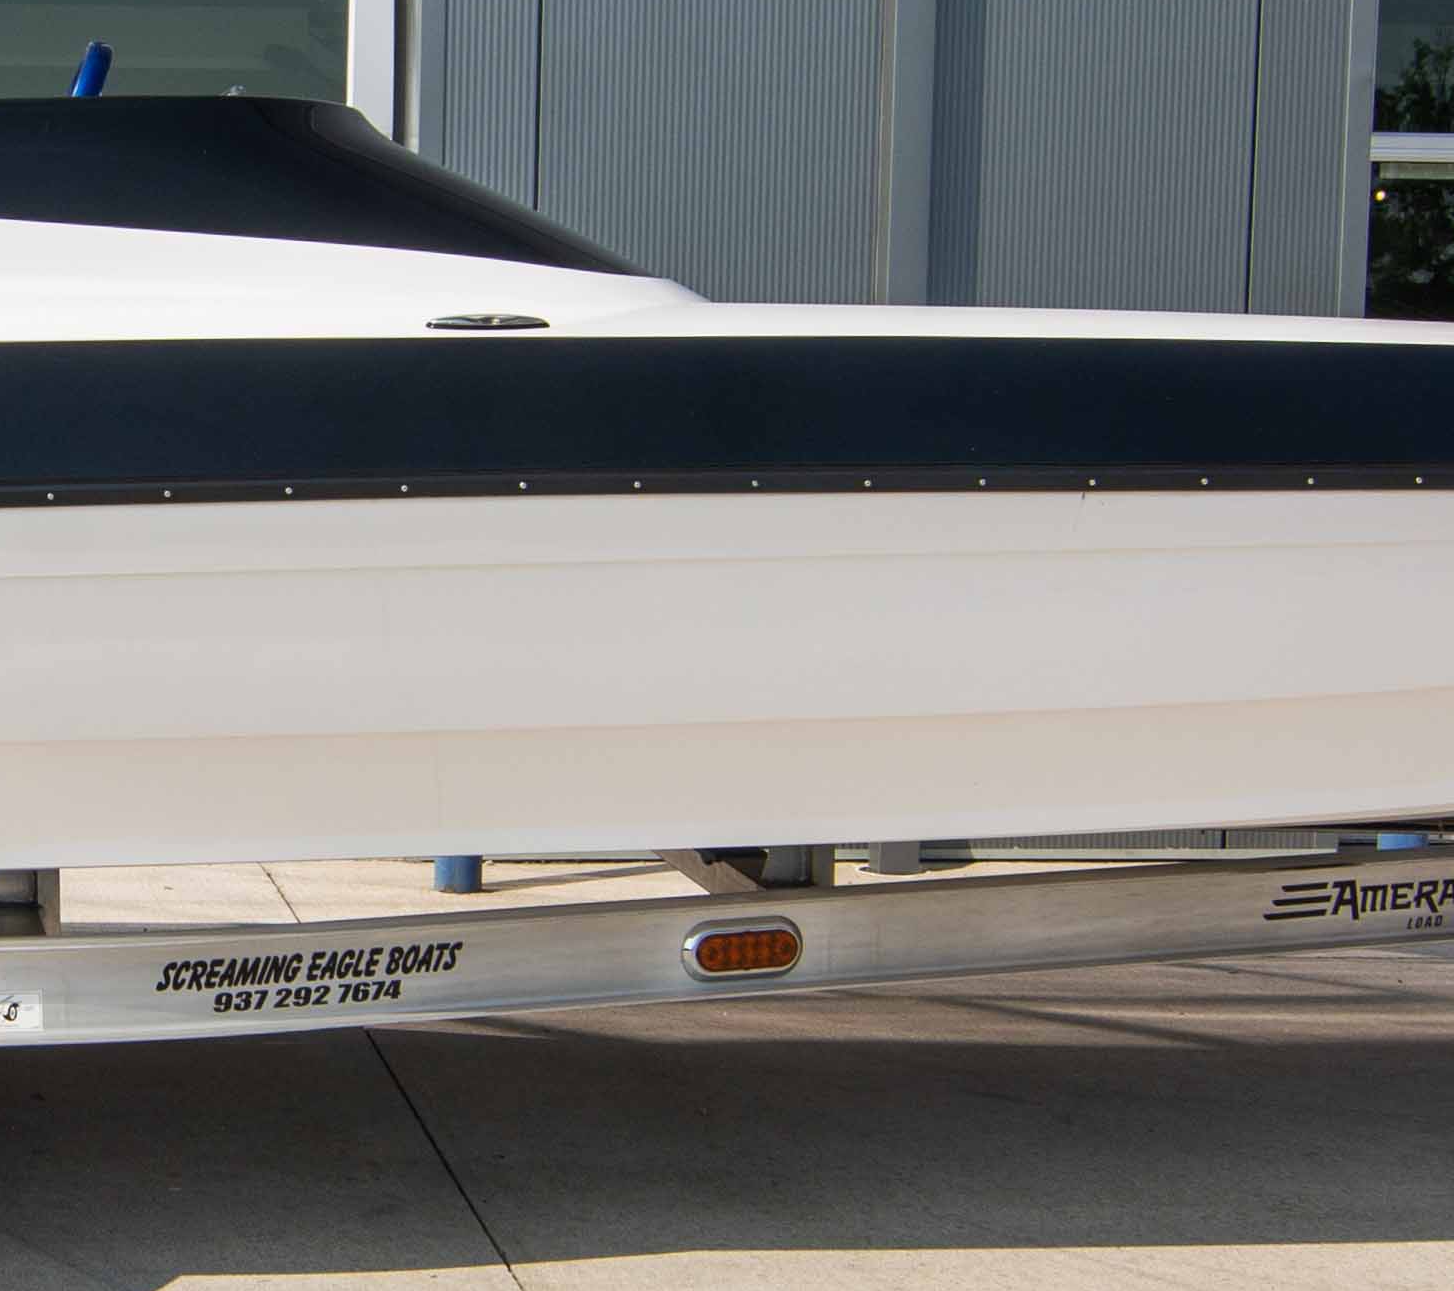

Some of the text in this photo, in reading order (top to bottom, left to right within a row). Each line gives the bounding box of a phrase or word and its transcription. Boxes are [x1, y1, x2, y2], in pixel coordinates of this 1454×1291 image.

[1407, 915, 1443, 930] LOAD
[156, 941, 464, 992] SCREAMING EAGLE BOATS
[213, 979, 402, 1013] 937 292 7674
